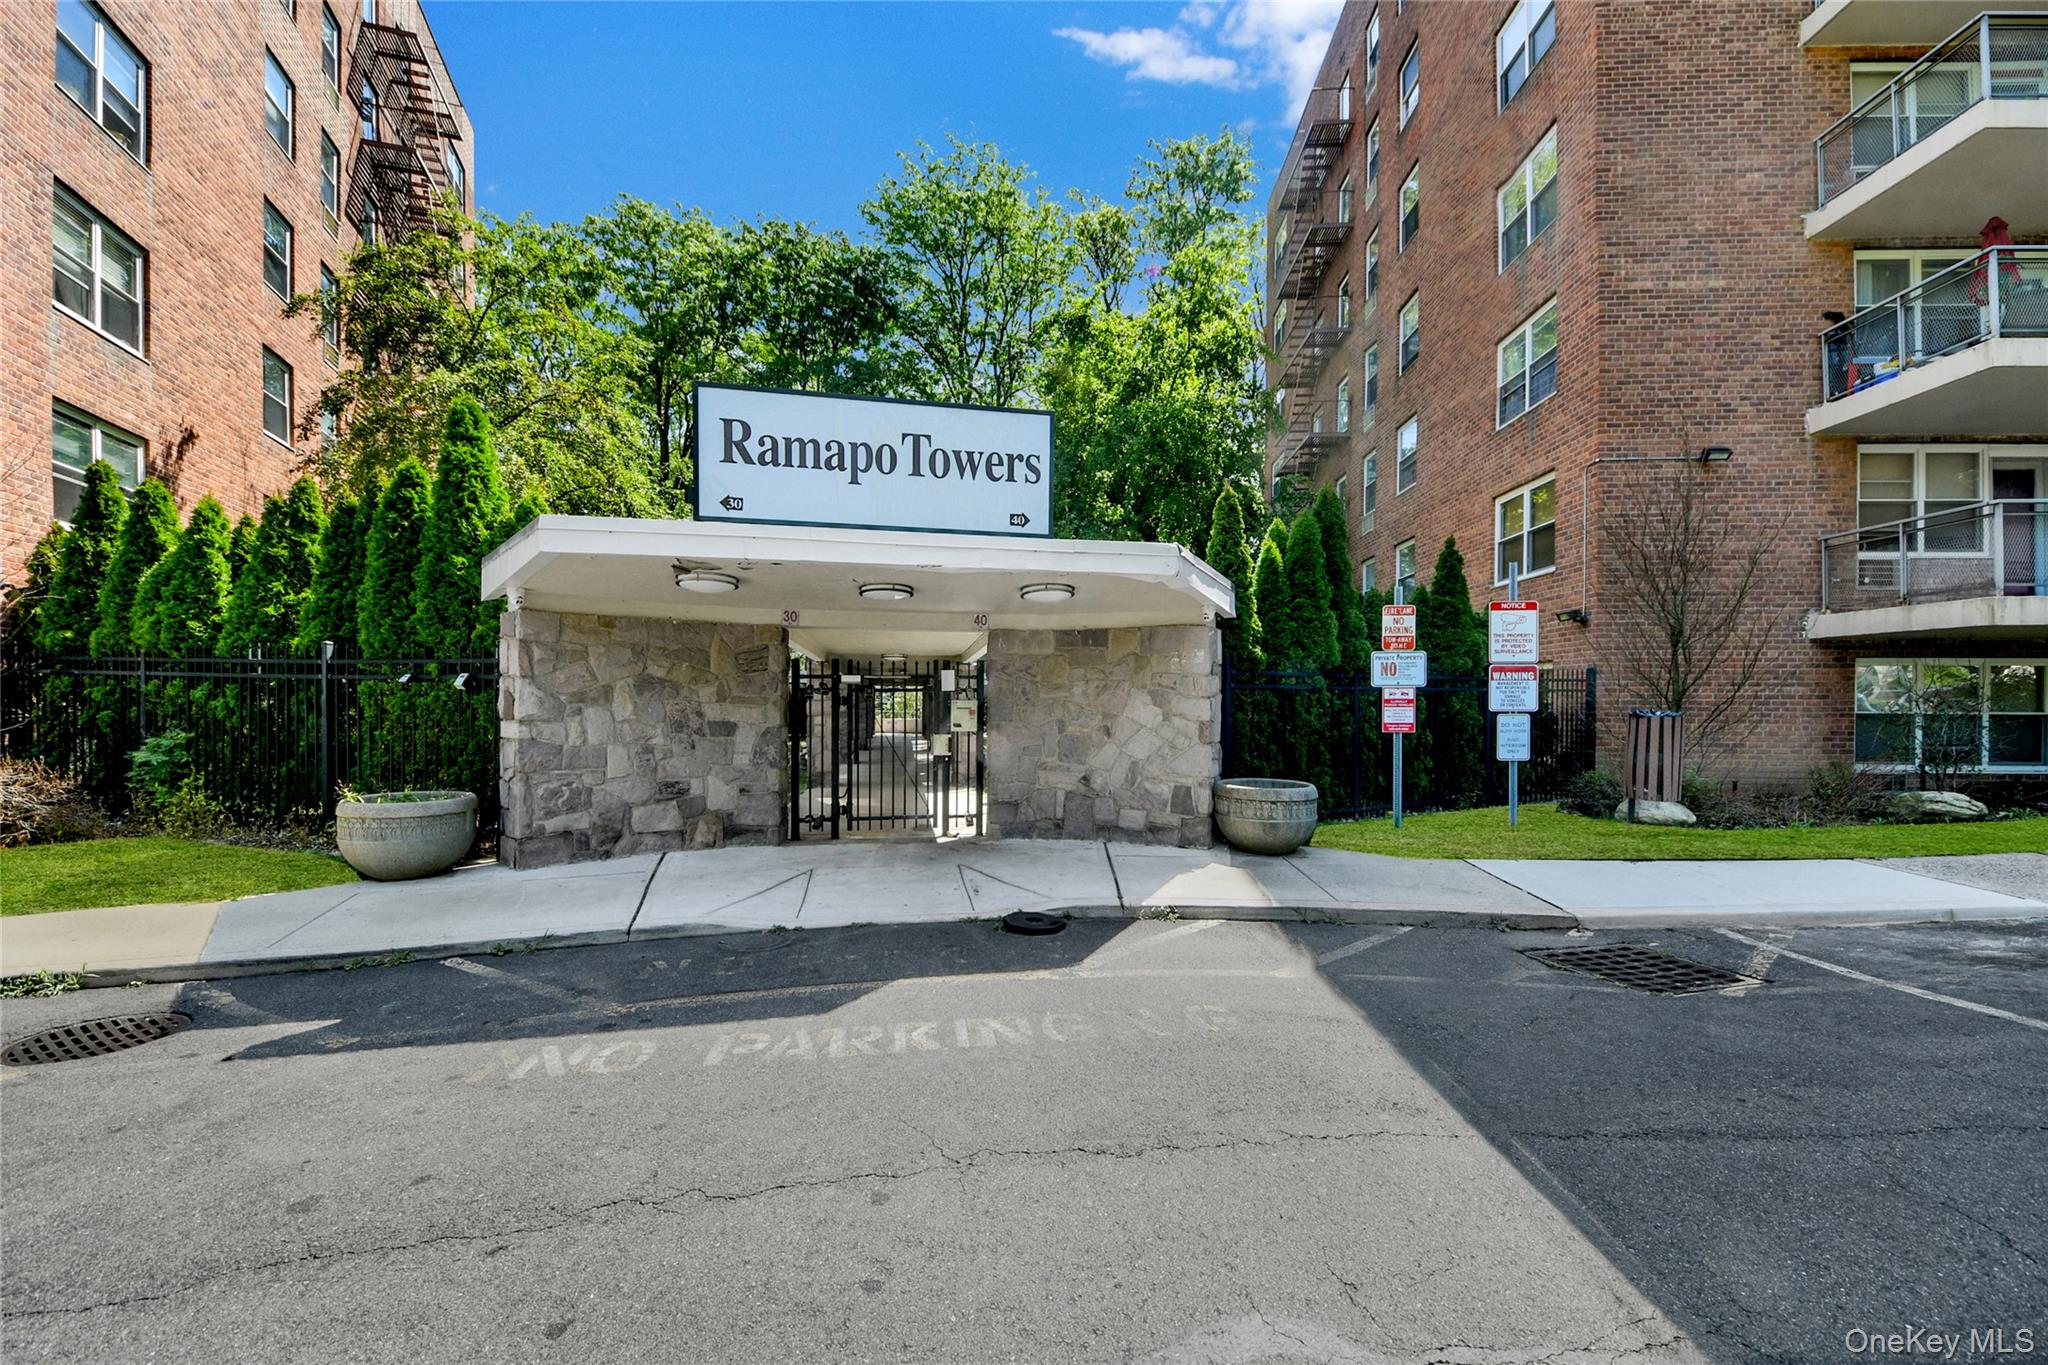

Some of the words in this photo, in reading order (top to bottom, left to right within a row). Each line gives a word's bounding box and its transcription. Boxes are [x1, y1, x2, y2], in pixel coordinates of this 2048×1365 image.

[719, 417, 897, 485] Ramapo
[901, 432, 1042, 485] Towers
[727, 498, 743, 510] 30
[1011, 514, 1025, 525] 40
[783, 611, 797, 622] 30
[1399, 607, 1414, 615] LANE
[974, 614, 988, 626] 40
[1393, 617, 1405, 626] NO
[1384, 626, 1414, 635] PARKING
[1380, 662, 1397, 676] NO
[1493, 671, 1535, 681] WARNING
[702, 1012, 1094, 1068] PARKING
